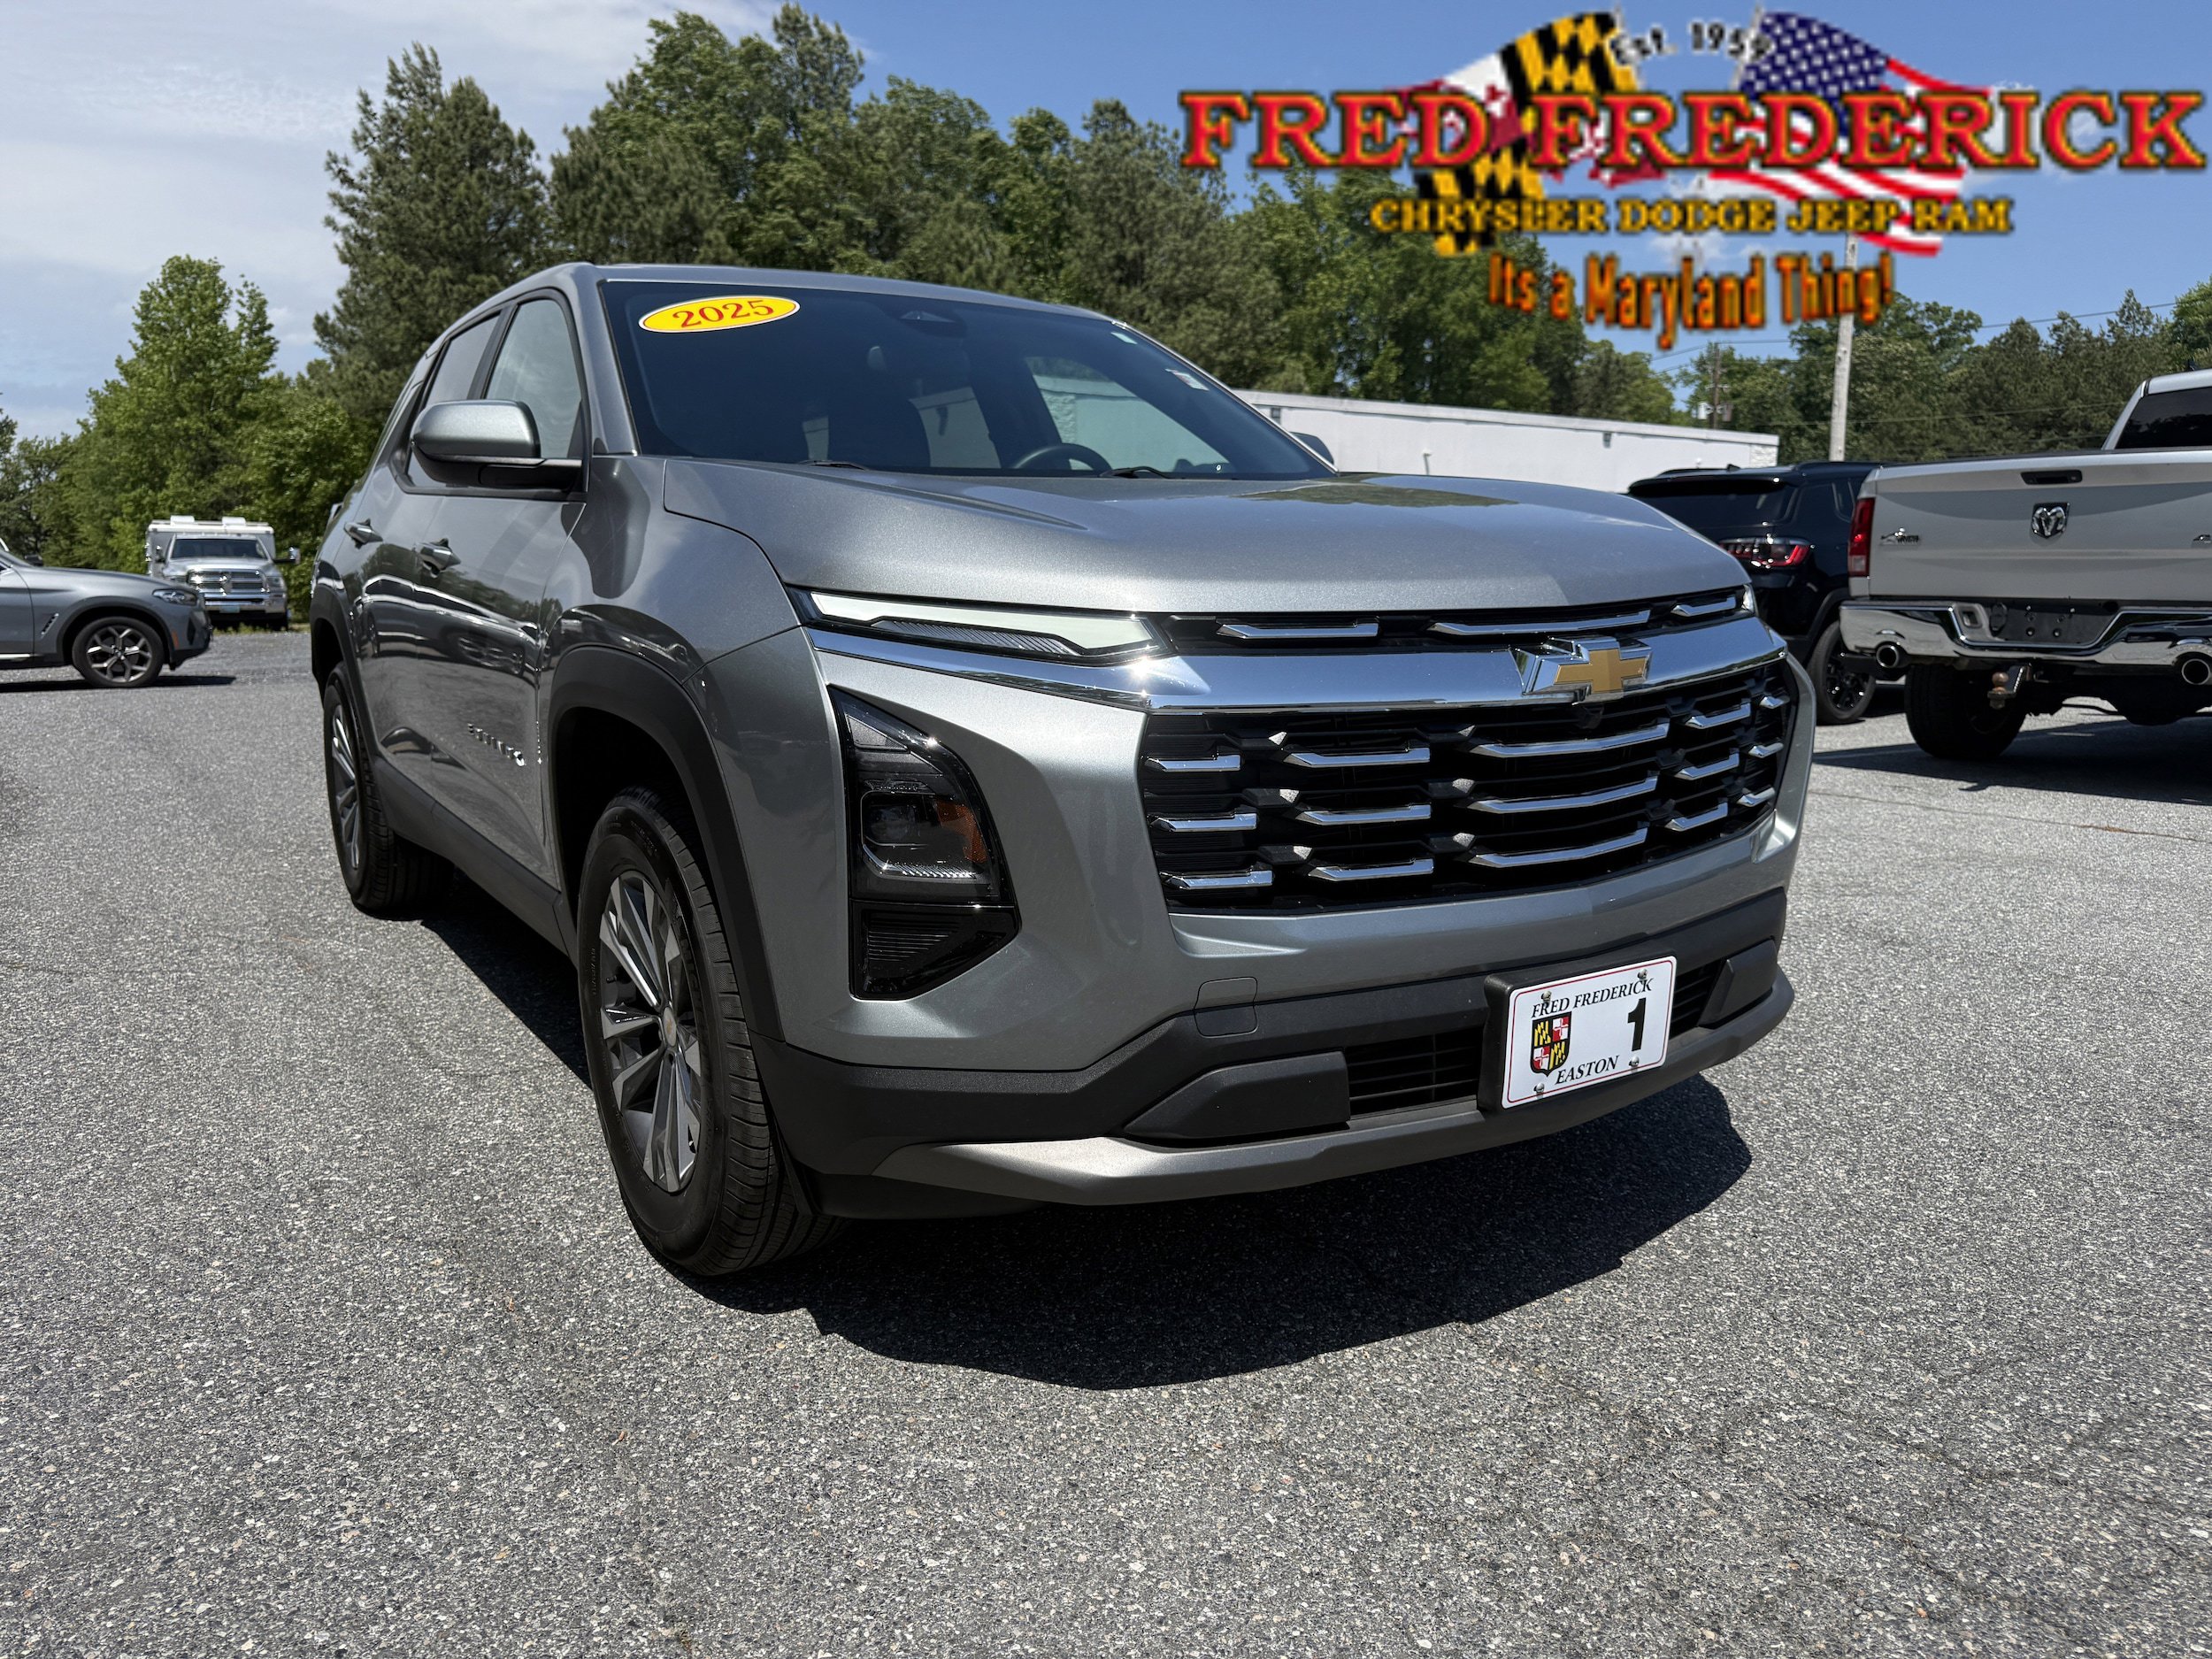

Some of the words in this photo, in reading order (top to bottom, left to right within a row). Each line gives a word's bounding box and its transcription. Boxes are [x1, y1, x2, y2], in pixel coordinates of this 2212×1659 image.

[672, 300, 774, 328] 2025
[1532, 997, 1570, 1018] FRED
[1573, 979, 1654, 1009] FREDERICK
[1628, 996, 1647, 1052] 1
[1555, 1055, 1619, 1085] EASTON
